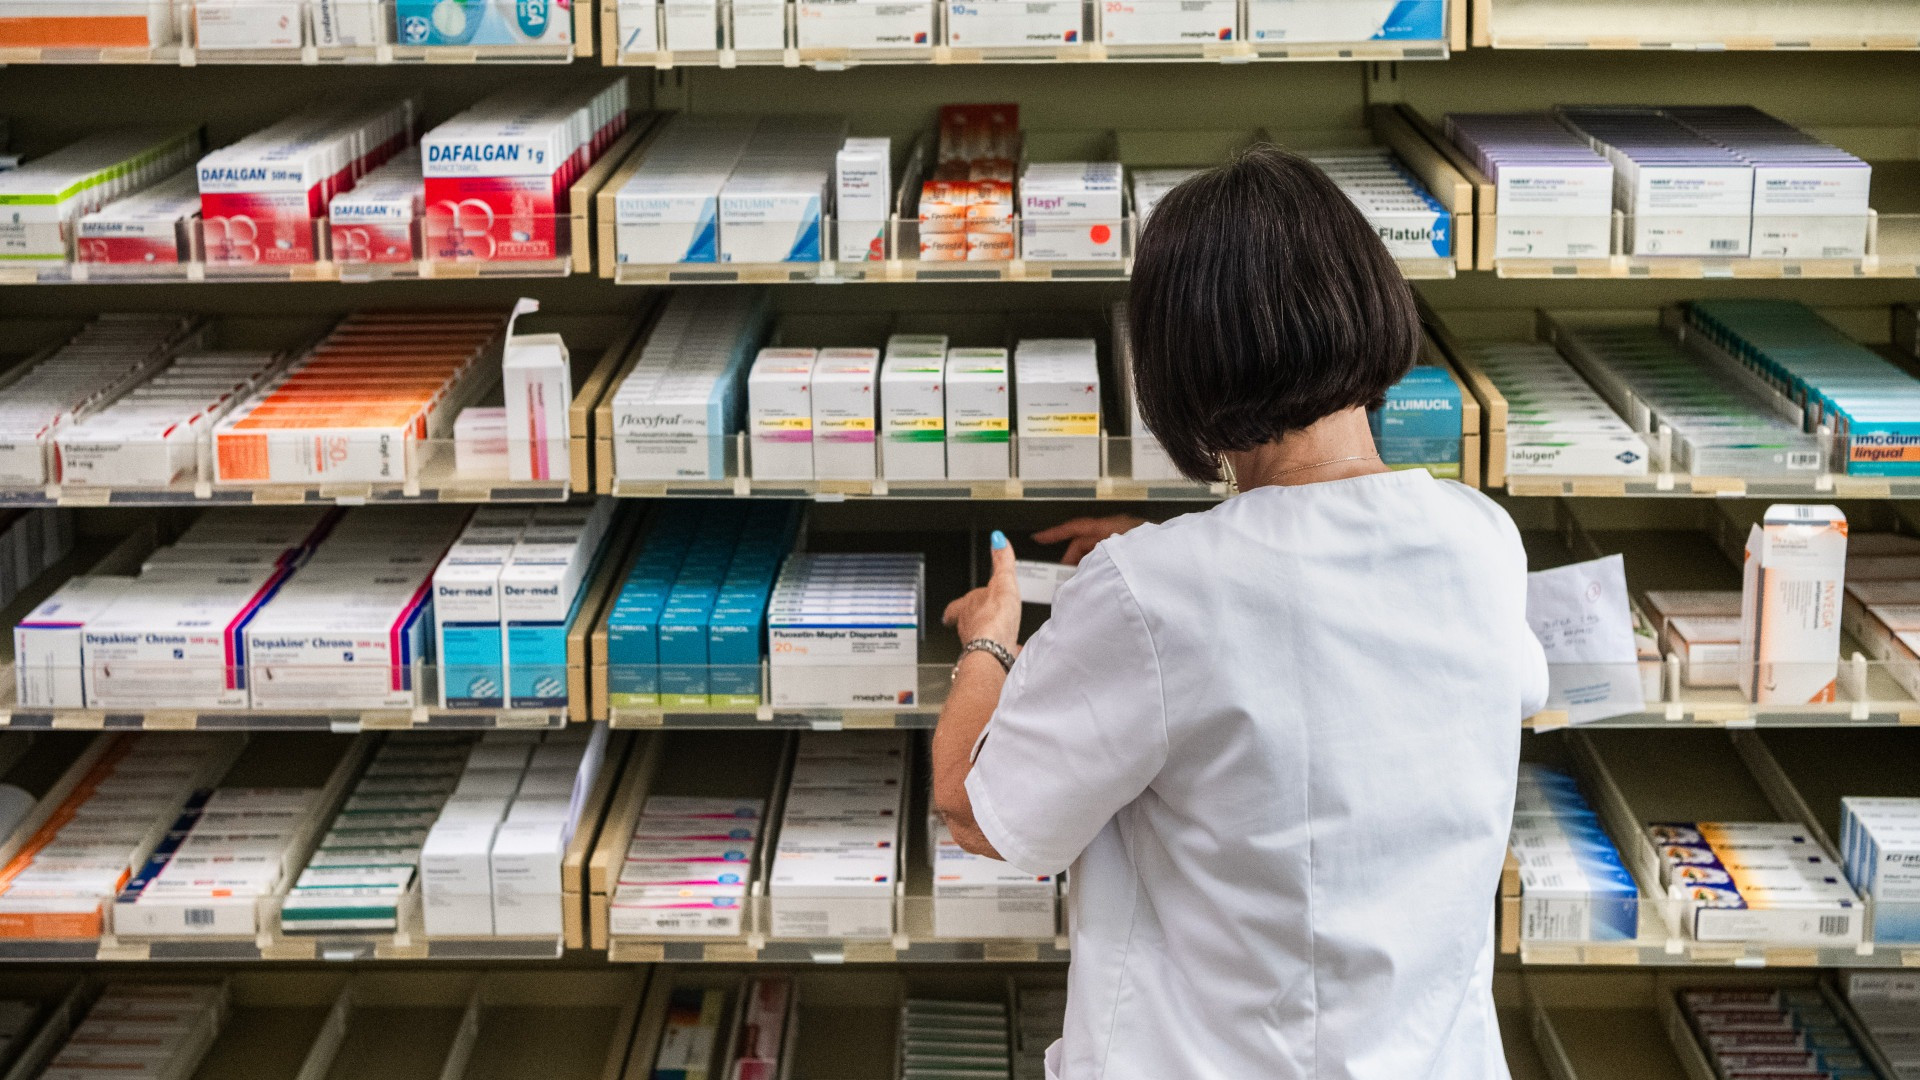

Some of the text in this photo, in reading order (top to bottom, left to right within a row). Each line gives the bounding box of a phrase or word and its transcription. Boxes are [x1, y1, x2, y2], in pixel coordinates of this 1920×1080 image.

[428, 144, 544, 164] DAFALGAN 1 g
[201, 167, 267, 182] DAFALGAN
[287, 172, 303, 183] mg
[619, 199, 671, 210] ENTUMIN
[723, 199, 775, 210] ENTUMIN
[1027, 196, 1062, 209] Flagyl
[334, 205, 389, 216] DAFALGAN
[82, 222, 124, 232] DAFALGAN
[1379, 226, 1446, 242] Flatulex
[1385, 398, 1453, 411] FLUIMUCIL
[1855, 433, 1920, 447] imodium
[1854, 447, 1904, 461] lingual
[439, 585, 493, 597] Der-med
[504, 585, 559, 597] Der-med
[145, 633, 186, 645] Chrono
[312, 638, 353, 649] Chrono
[852, 693, 895, 702] mepha
